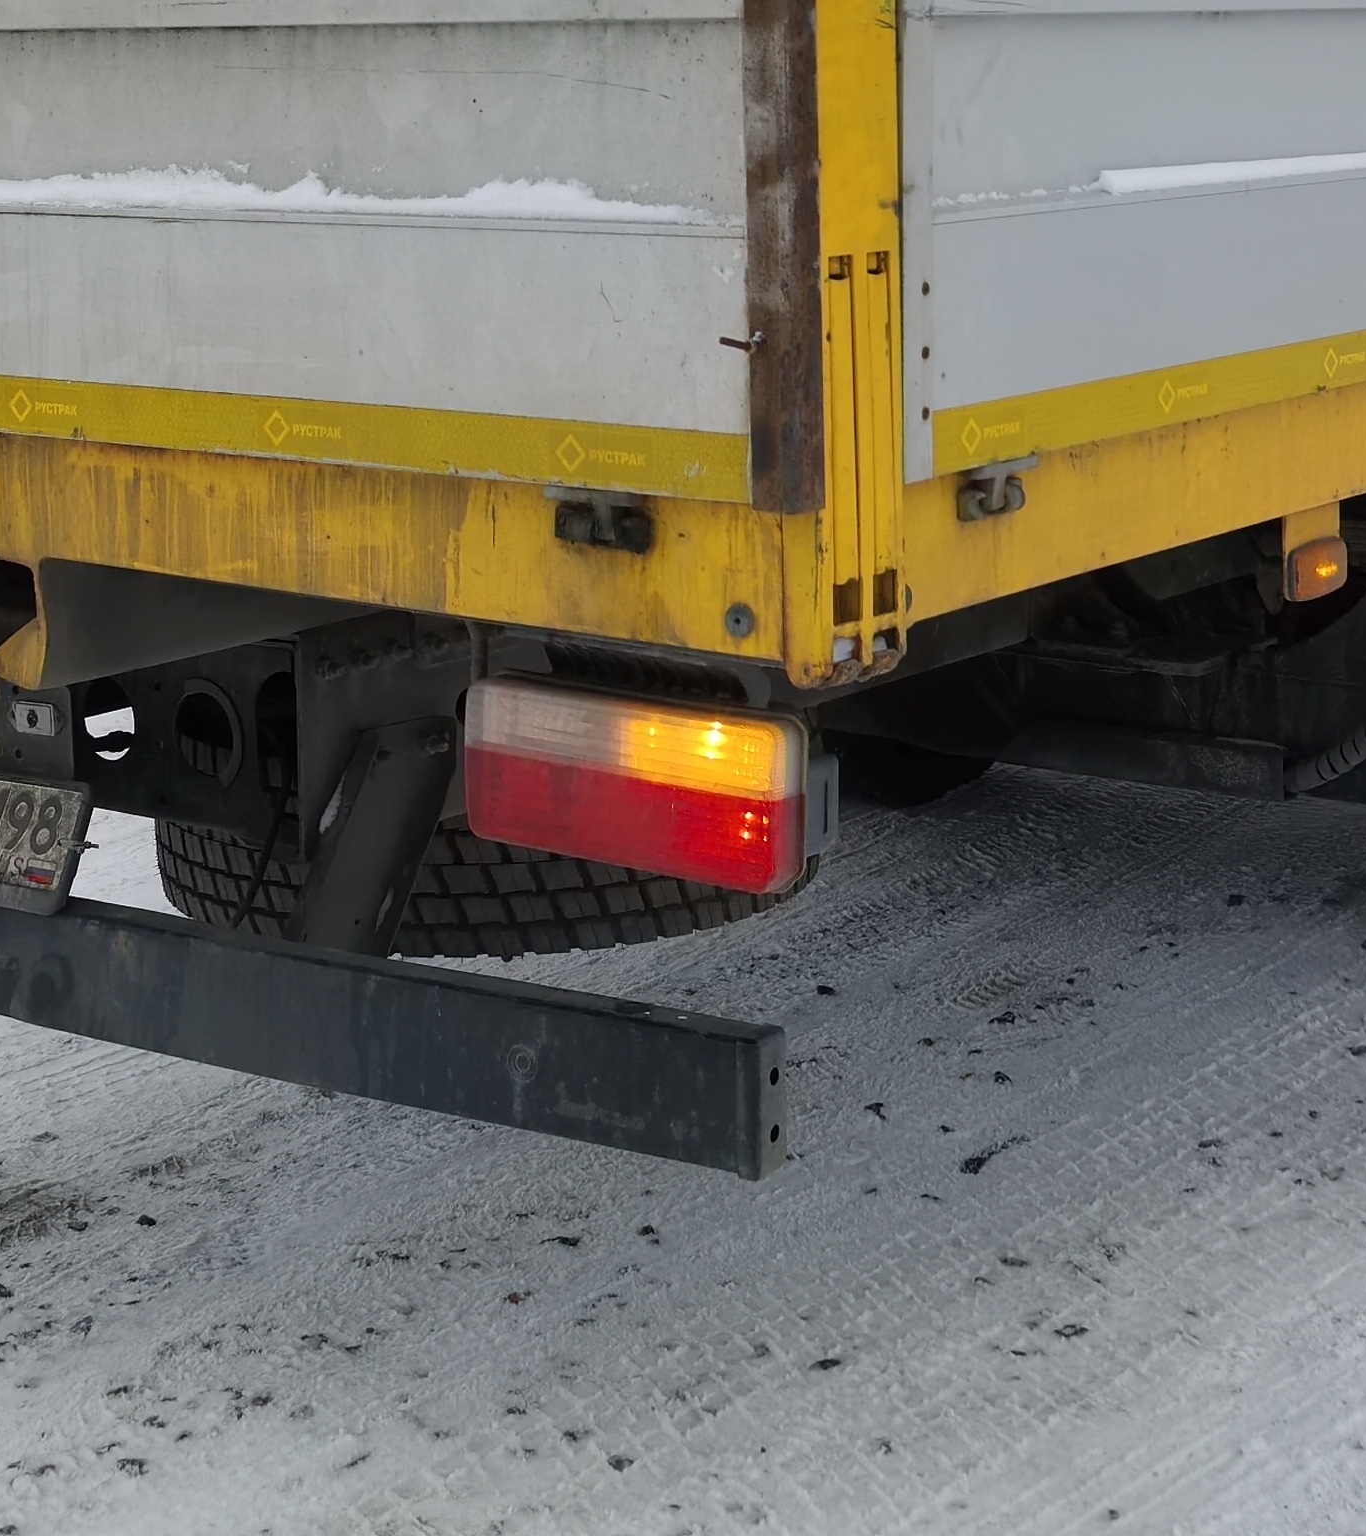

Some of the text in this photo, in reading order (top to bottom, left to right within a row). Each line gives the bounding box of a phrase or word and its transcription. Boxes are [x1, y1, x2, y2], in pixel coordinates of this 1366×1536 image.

[34, 401, 78, 417] РУСТРАК
[291, 423, 342, 440] РУСТРАК
[588, 448, 647, 468] РУСТРАК
